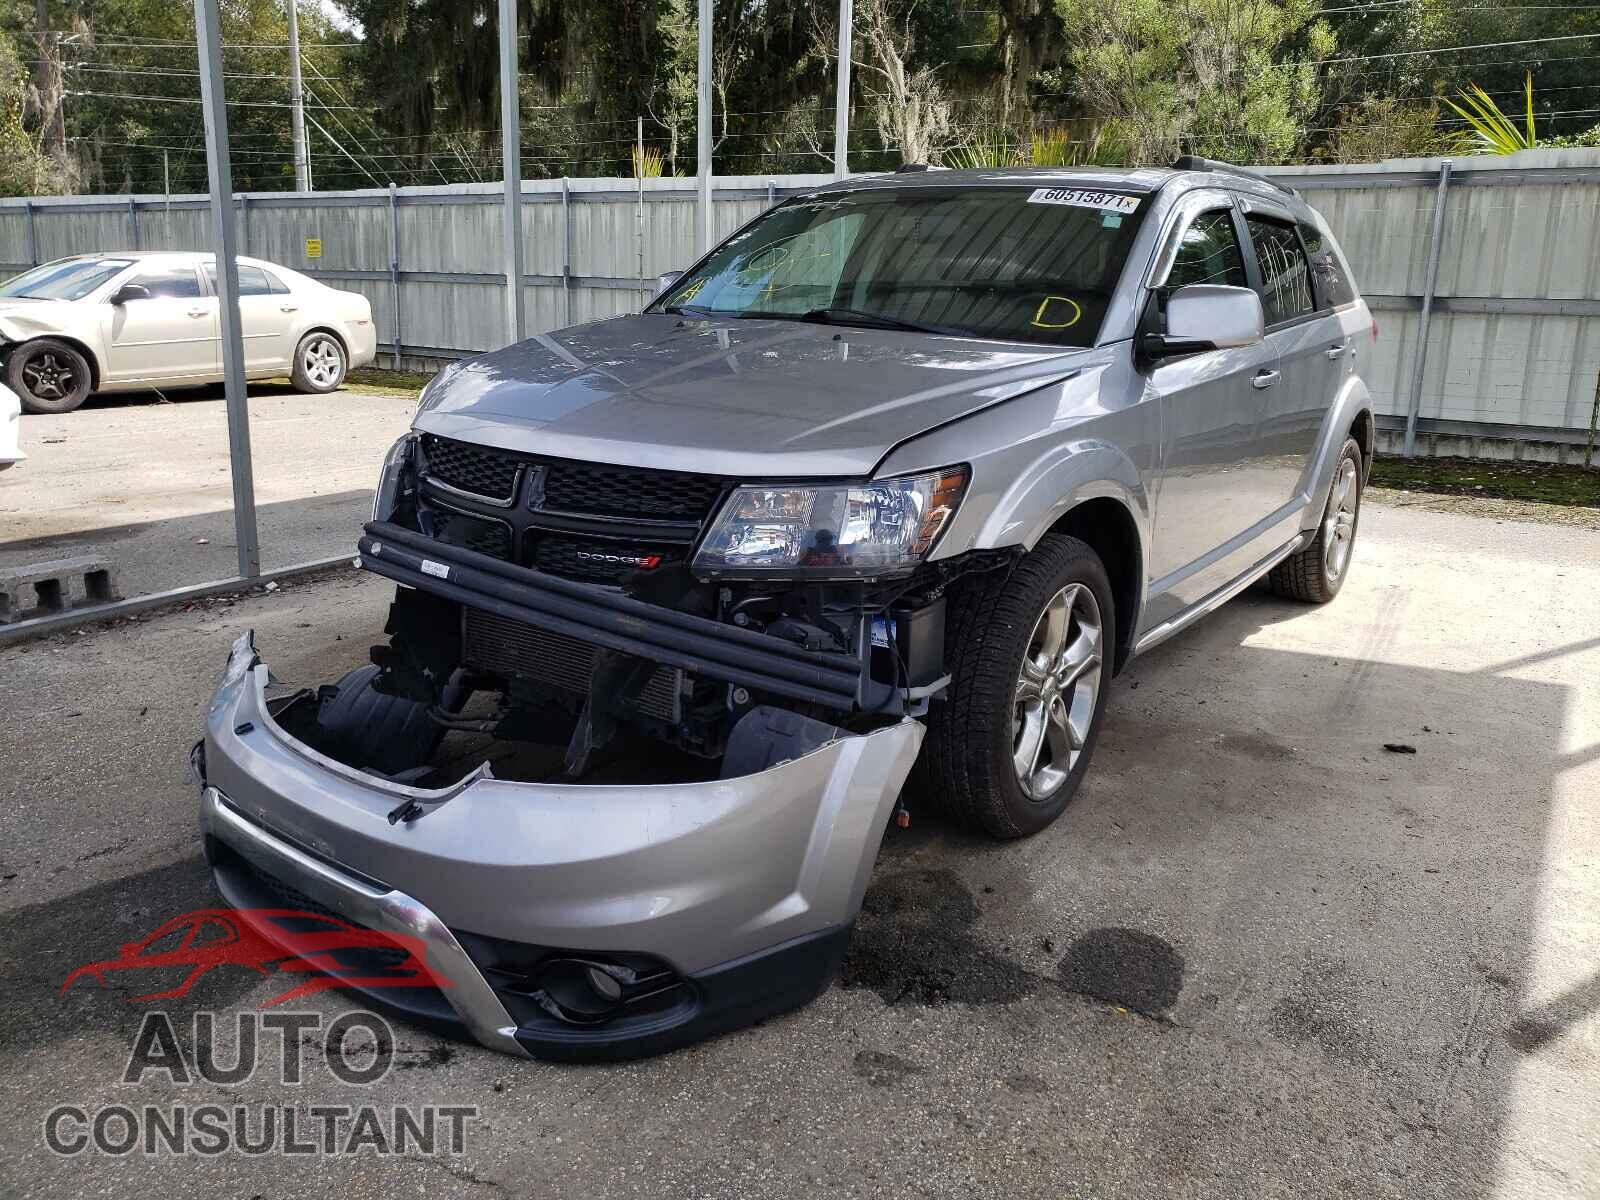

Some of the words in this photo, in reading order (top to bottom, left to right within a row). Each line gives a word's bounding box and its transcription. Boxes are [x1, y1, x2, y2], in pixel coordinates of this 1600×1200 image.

[1043, 188, 1125, 208] 60515871
[1030, 295, 1081, 328] D
[577, 551, 649, 566] DODGE
